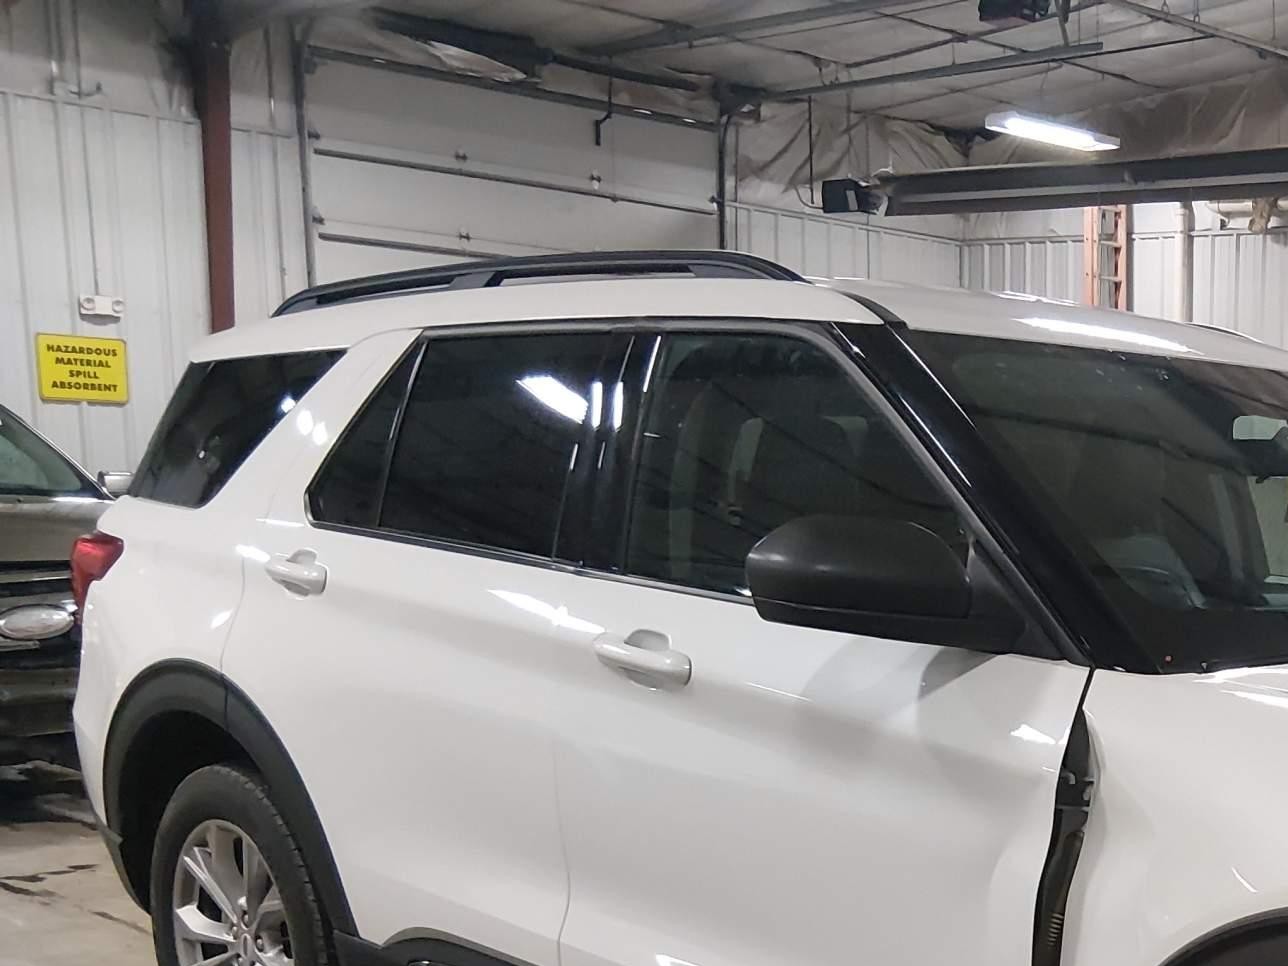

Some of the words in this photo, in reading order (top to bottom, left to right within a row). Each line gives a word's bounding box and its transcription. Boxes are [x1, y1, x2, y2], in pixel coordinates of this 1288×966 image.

[46, 344, 118, 357] HAZARDOUS
[55, 357, 112, 368] MATERIAL
[68, 369, 100, 379] SPILL
[51, 380, 118, 393] ABSORBENT
